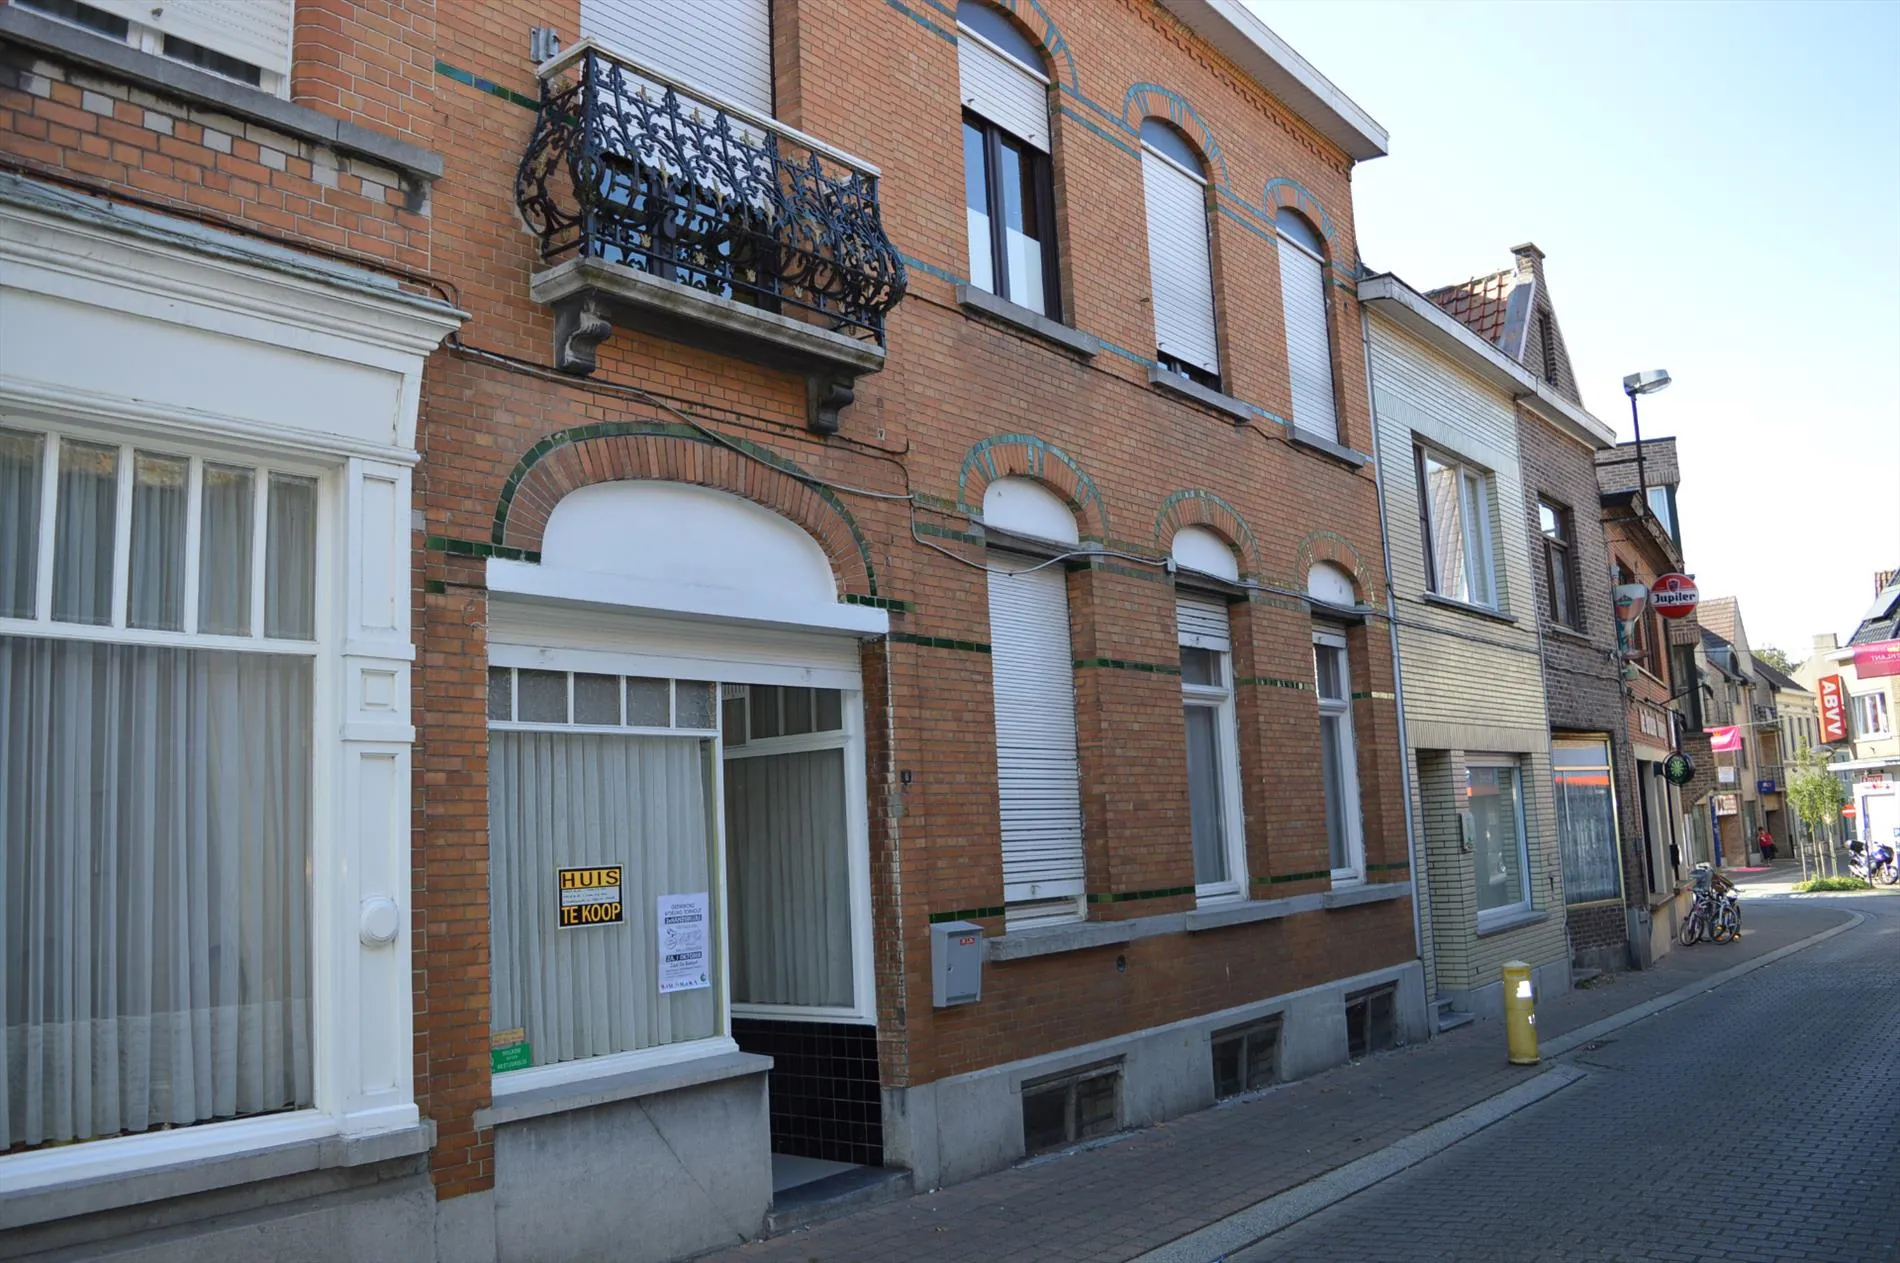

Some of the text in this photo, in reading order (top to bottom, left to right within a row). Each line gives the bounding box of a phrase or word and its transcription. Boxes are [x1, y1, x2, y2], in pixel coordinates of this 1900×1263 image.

[1654, 592, 1696, 604] Jupiler
[1821, 680, 1842, 735] ABVV
[562, 870, 619, 888] HUIS
[561, 902, 621, 925] TE KOOP
